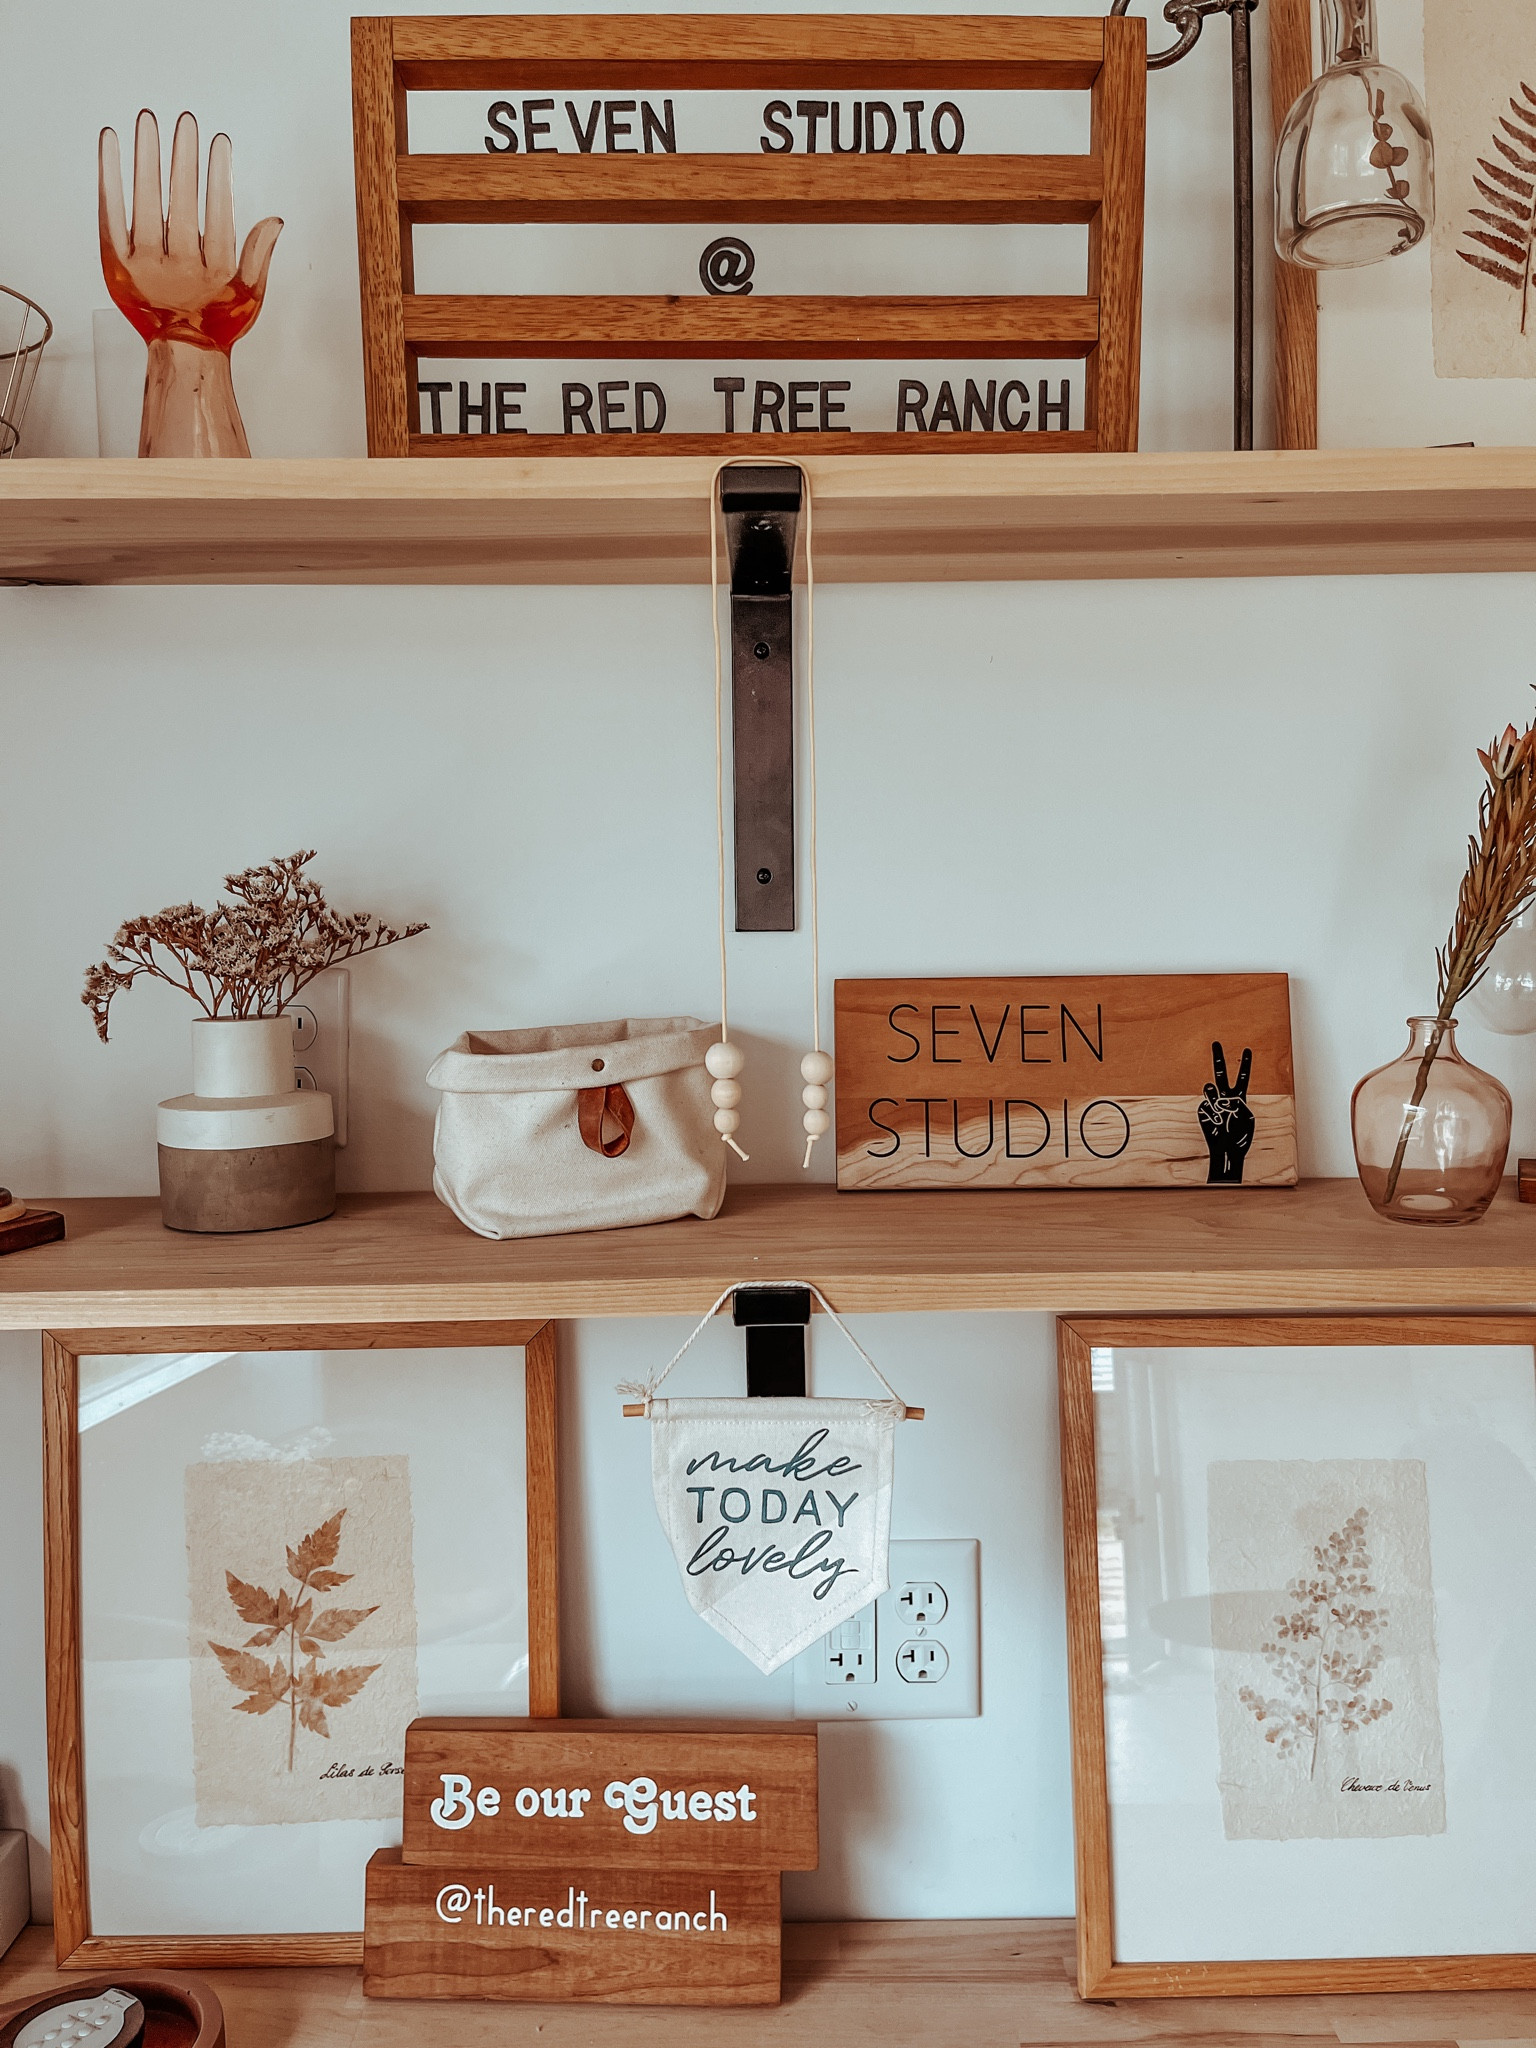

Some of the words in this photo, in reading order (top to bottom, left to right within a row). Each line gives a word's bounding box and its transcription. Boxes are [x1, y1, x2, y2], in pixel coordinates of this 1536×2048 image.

[485, 99, 676, 154] SEVEN
[760, 99, 965, 154] STUDIO
[699, 237, 756, 295] @
[416, 381, 527, 434] THE
[562, 381, 667, 434] RED
[713, 377, 852, 432] TREE
[897, 379, 1070, 432] RANCH
[887, 1003, 1104, 1063] SEVEN
[867, 1097, 1130, 1159] STUDIO
[686, 1428, 862, 1481] make
[686, 1487, 859, 1527] TODAY
[686, 1526, 859, 1600] lovely
[430, 1773, 500, 1830] Be
[514, 1786, 591, 1818] our
[603, 1776, 757, 1834] Guest
[435, 1884, 728, 1932] @theredtreeranch
